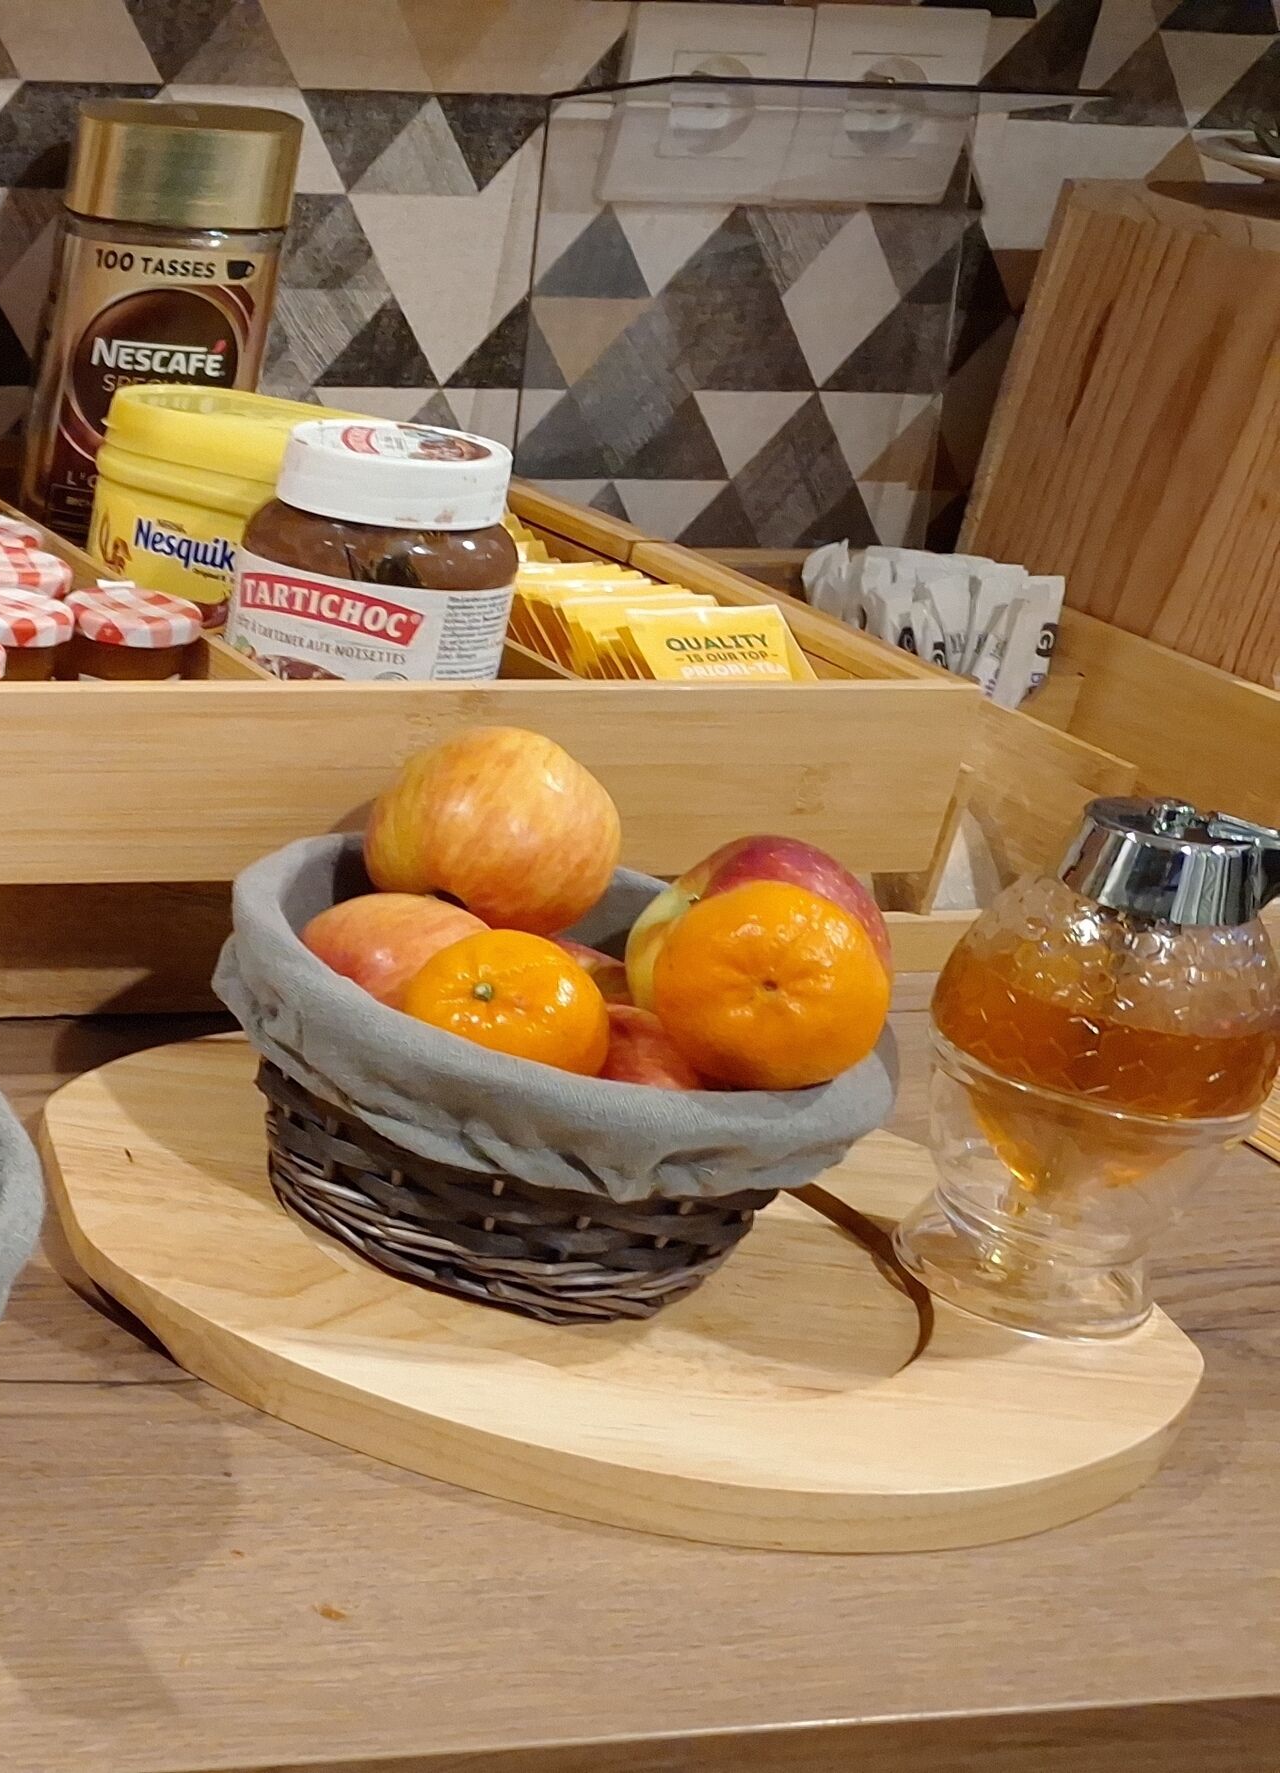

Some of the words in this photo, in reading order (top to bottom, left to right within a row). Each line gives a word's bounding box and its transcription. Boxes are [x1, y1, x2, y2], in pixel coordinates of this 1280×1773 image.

[95, 248, 134, 271] 100
[141, 257, 216, 278] TASSES
[91, 337, 226, 377] NESCAFÉ
[135, 518, 234, 571] Nesquik
[244, 579, 409, 638] TARTICHOC
[335, 646, 407, 665] NOISETTES
[666, 634, 768, 651] QUALITY
[686, 653, 703, 662] IS
[707, 652, 738, 662] OUR
[742, 651, 769, 660] TOP
